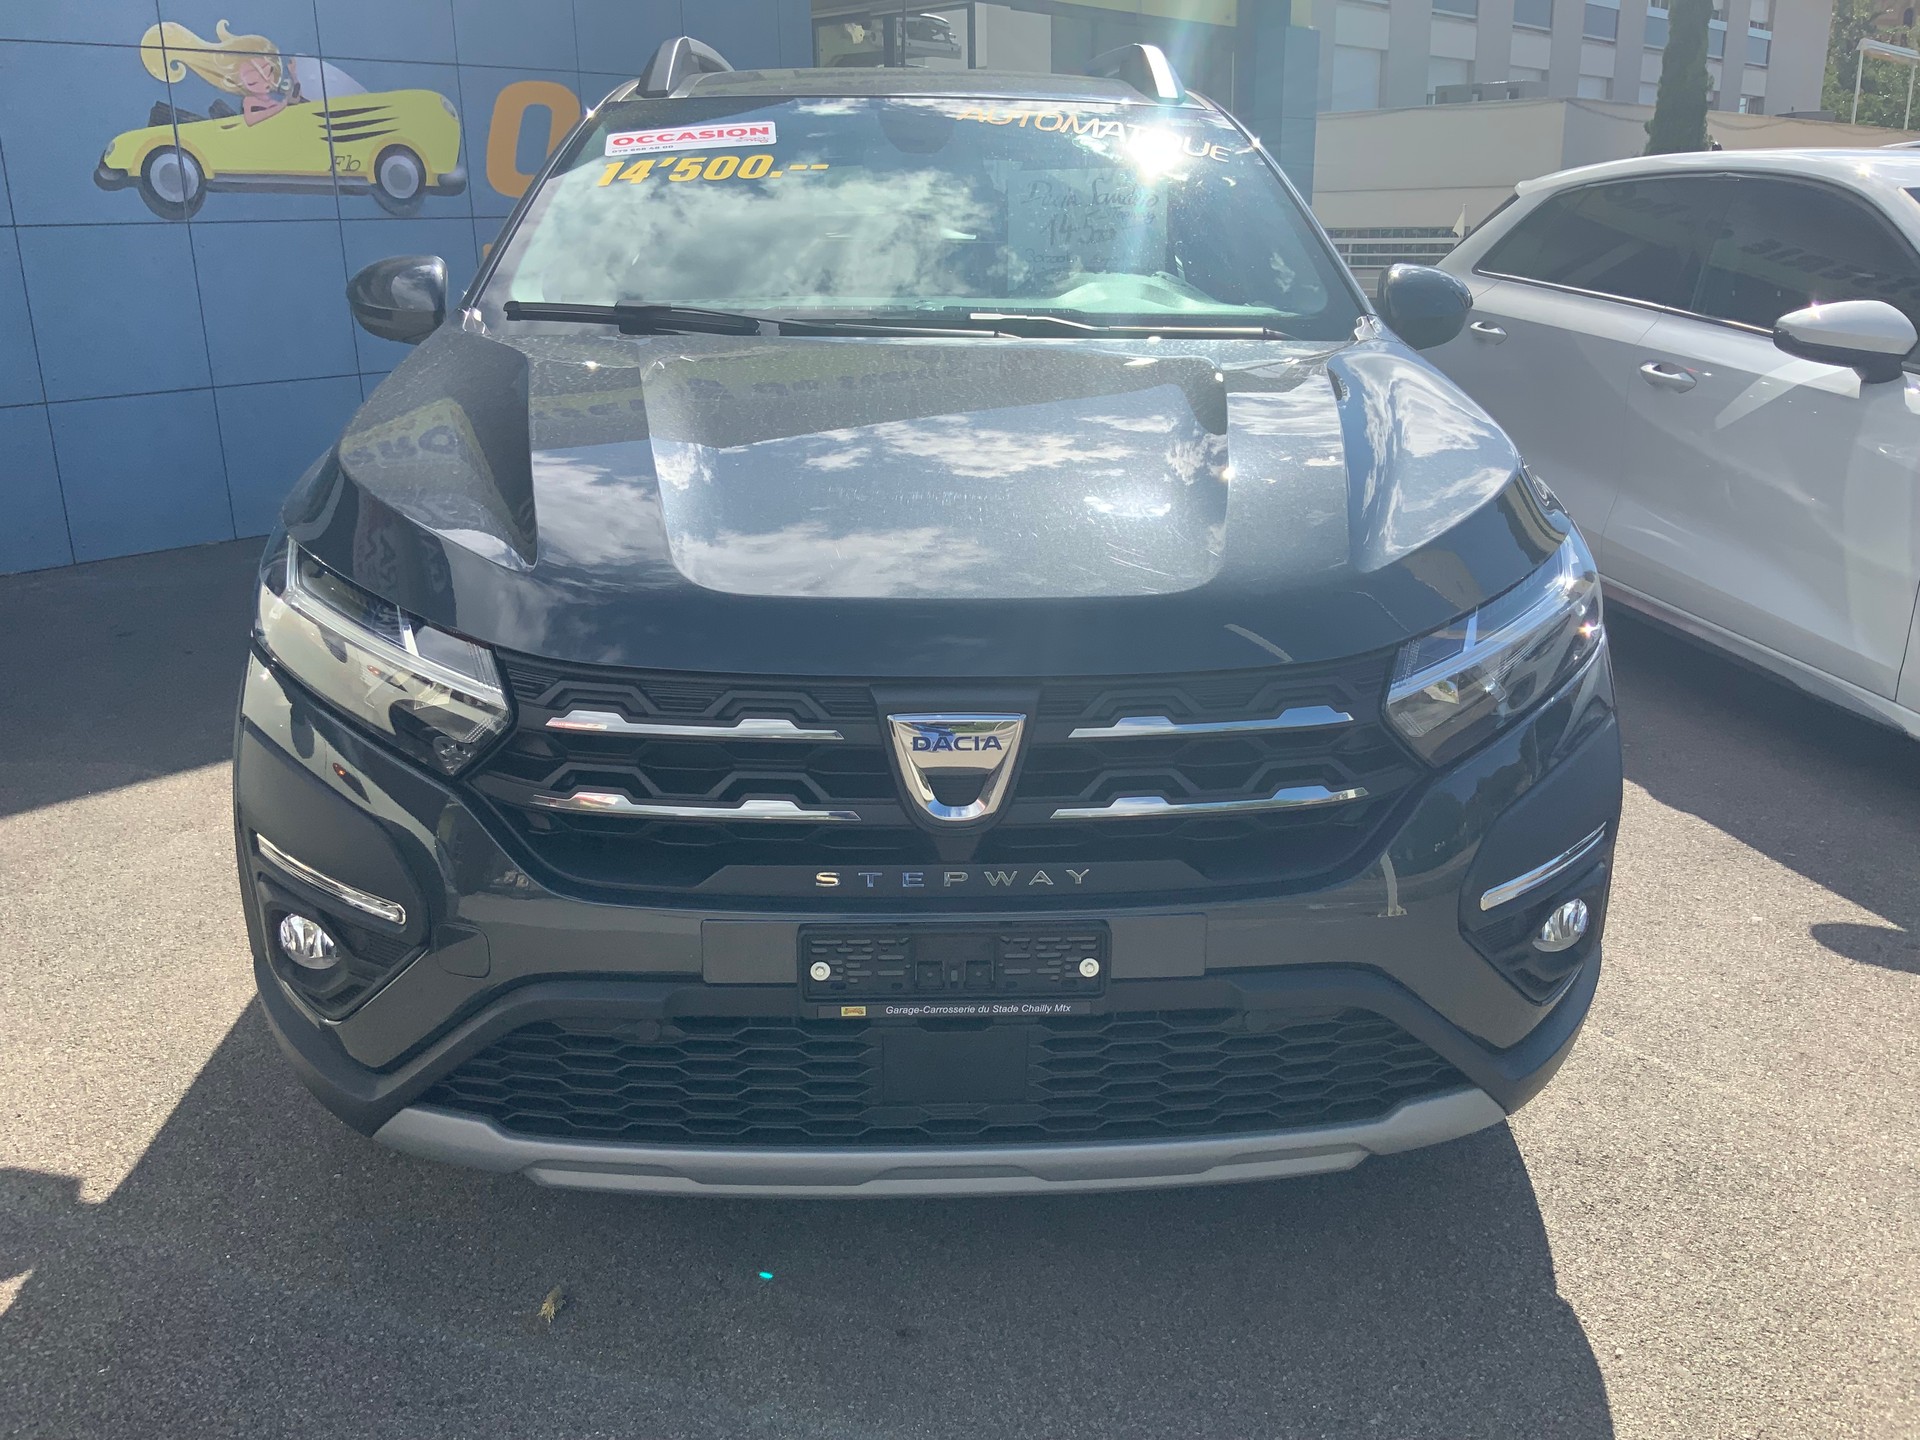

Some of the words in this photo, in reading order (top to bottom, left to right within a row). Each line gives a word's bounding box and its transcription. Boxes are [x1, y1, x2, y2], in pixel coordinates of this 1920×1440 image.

[612, 126, 770, 146] OCCASION
[955, 106, 1232, 163] AUTOMATUE
[911, 735, 1002, 751] DACIA
[815, 868, 1090, 888] STEPWAY
[885, 1004, 976, 1016] Garage-Carrosserie
[977, 1004, 990, 1014] du
[992, 1004, 1019, 1014] Stade
[1021, 1003, 1052, 1014] Chailly
[1053, 1003, 1072, 1013] Mtx
